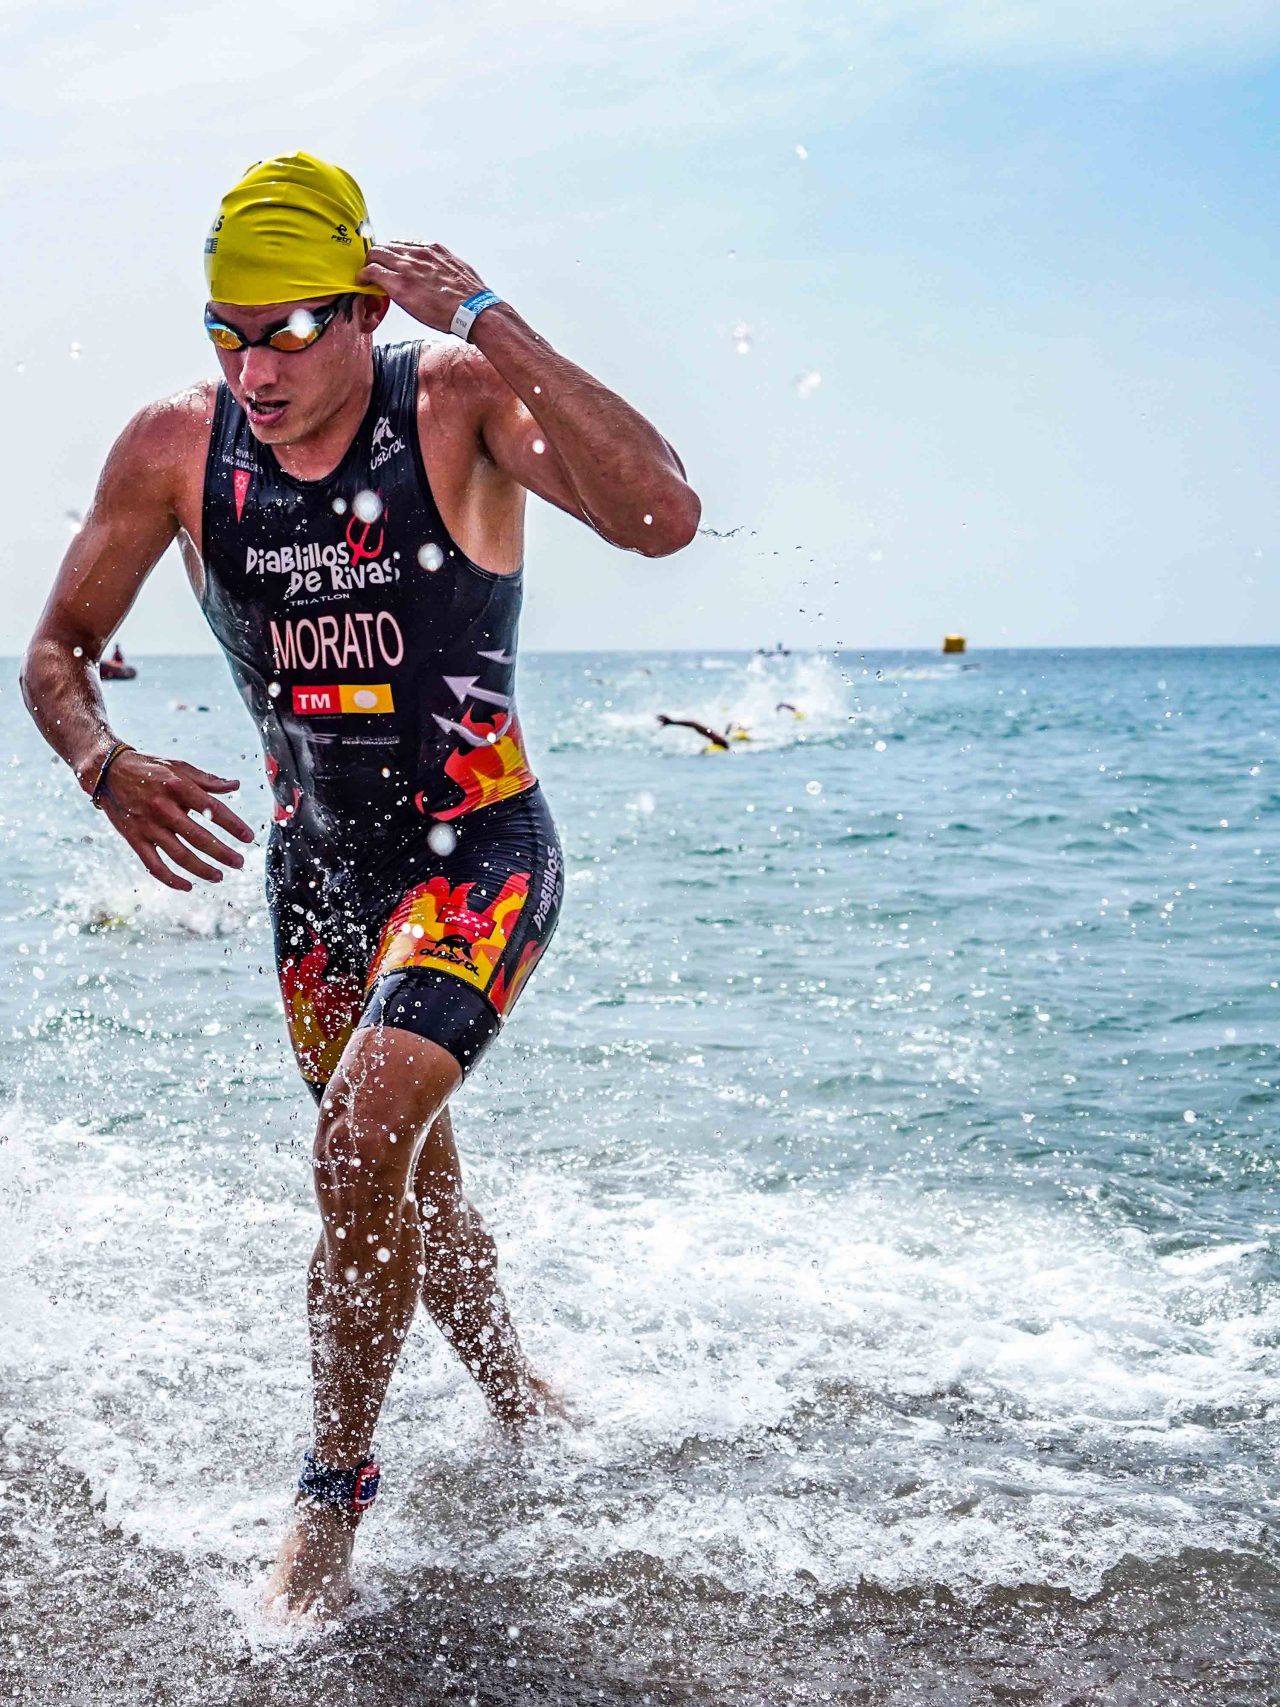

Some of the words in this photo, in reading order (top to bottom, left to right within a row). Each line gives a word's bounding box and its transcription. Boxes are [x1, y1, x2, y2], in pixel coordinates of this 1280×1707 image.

[235, 448, 254, 461] RIVAS
[290, 571, 322, 597] De
[289, 592, 350, 607] TRIATLON
[270, 610, 404, 671] MORATO
[297, 693, 332, 709] TM
